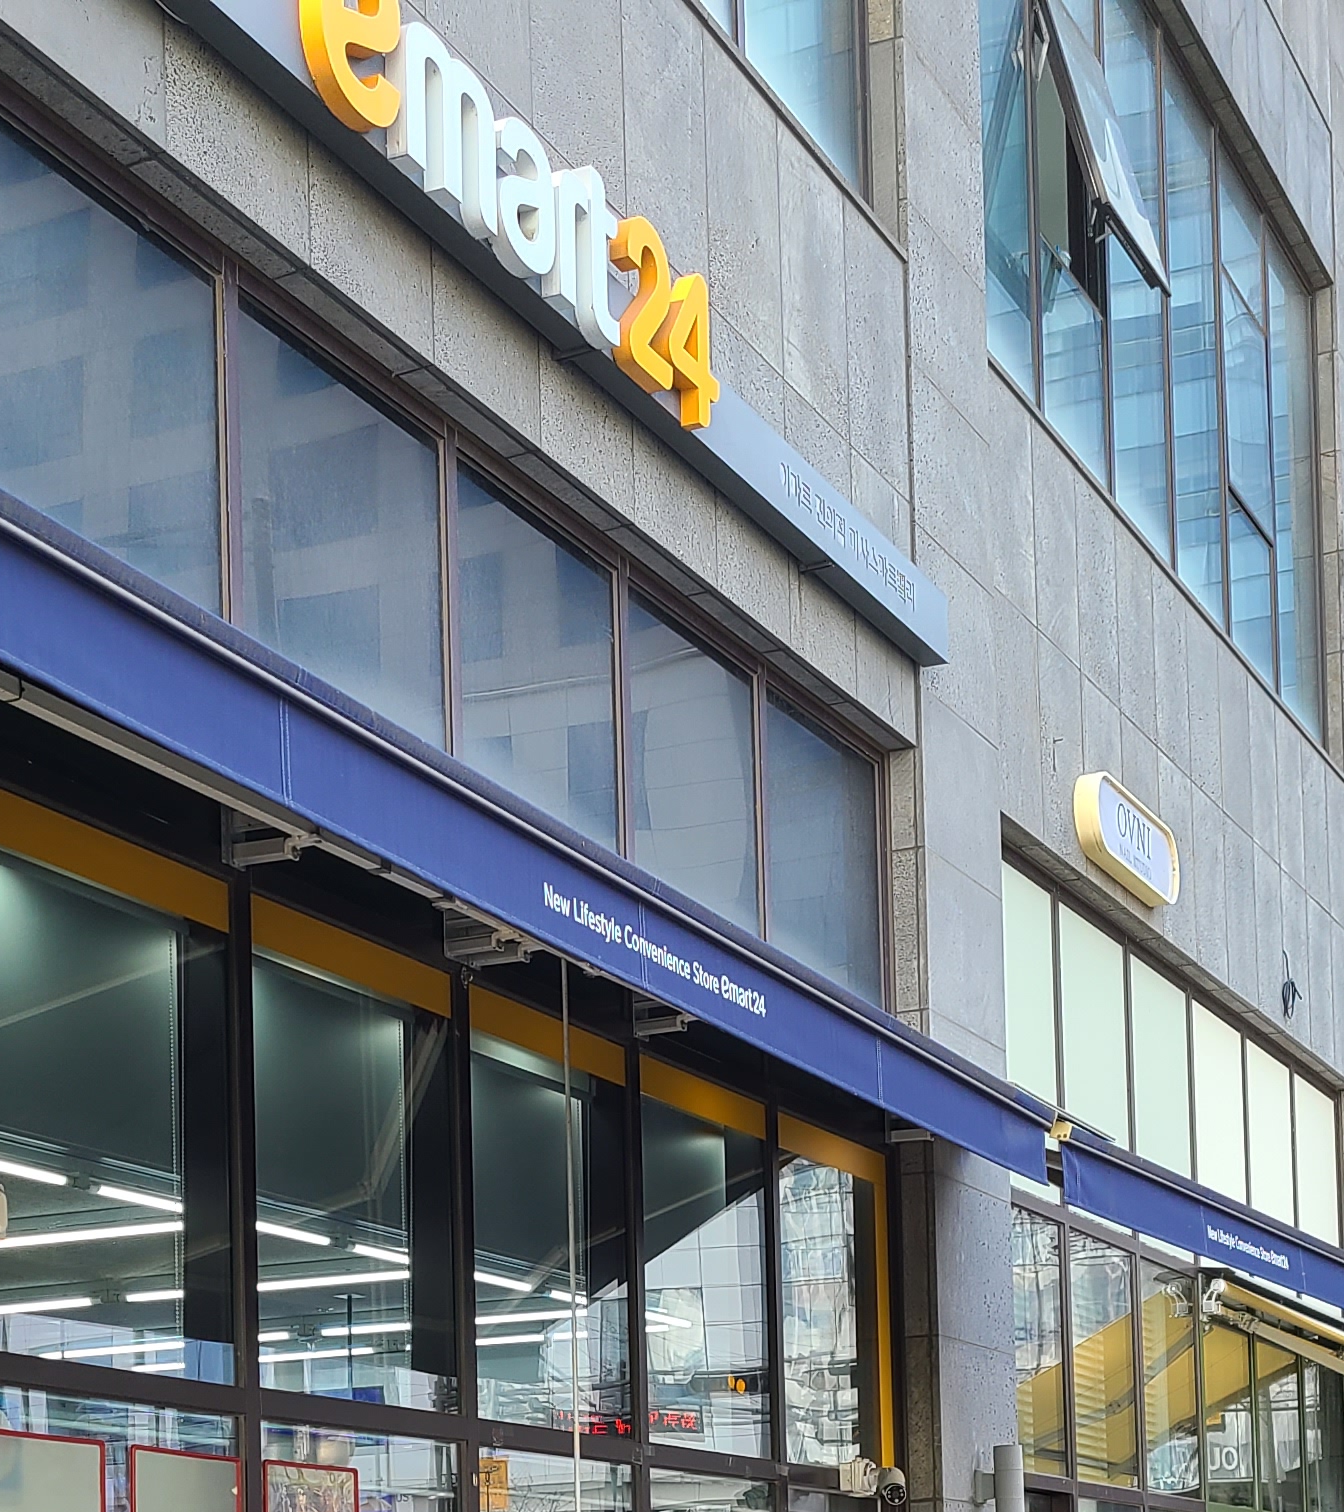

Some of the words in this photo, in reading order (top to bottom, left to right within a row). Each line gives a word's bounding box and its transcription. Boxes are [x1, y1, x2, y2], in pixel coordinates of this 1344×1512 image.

[300, 0, 720, 431] emart24
[780, 462, 812, 514] 이마트
[815, 493, 846, 548] 편의점
[1117, 803, 1151, 861] OVNI
[543, 881, 570, 917] New
[573, 897, 622, 943] Lifestyle
[624, 925, 691, 980] Convenience
[692, 961, 720, 994] Store
[721, 974, 767, 1018] emart24
